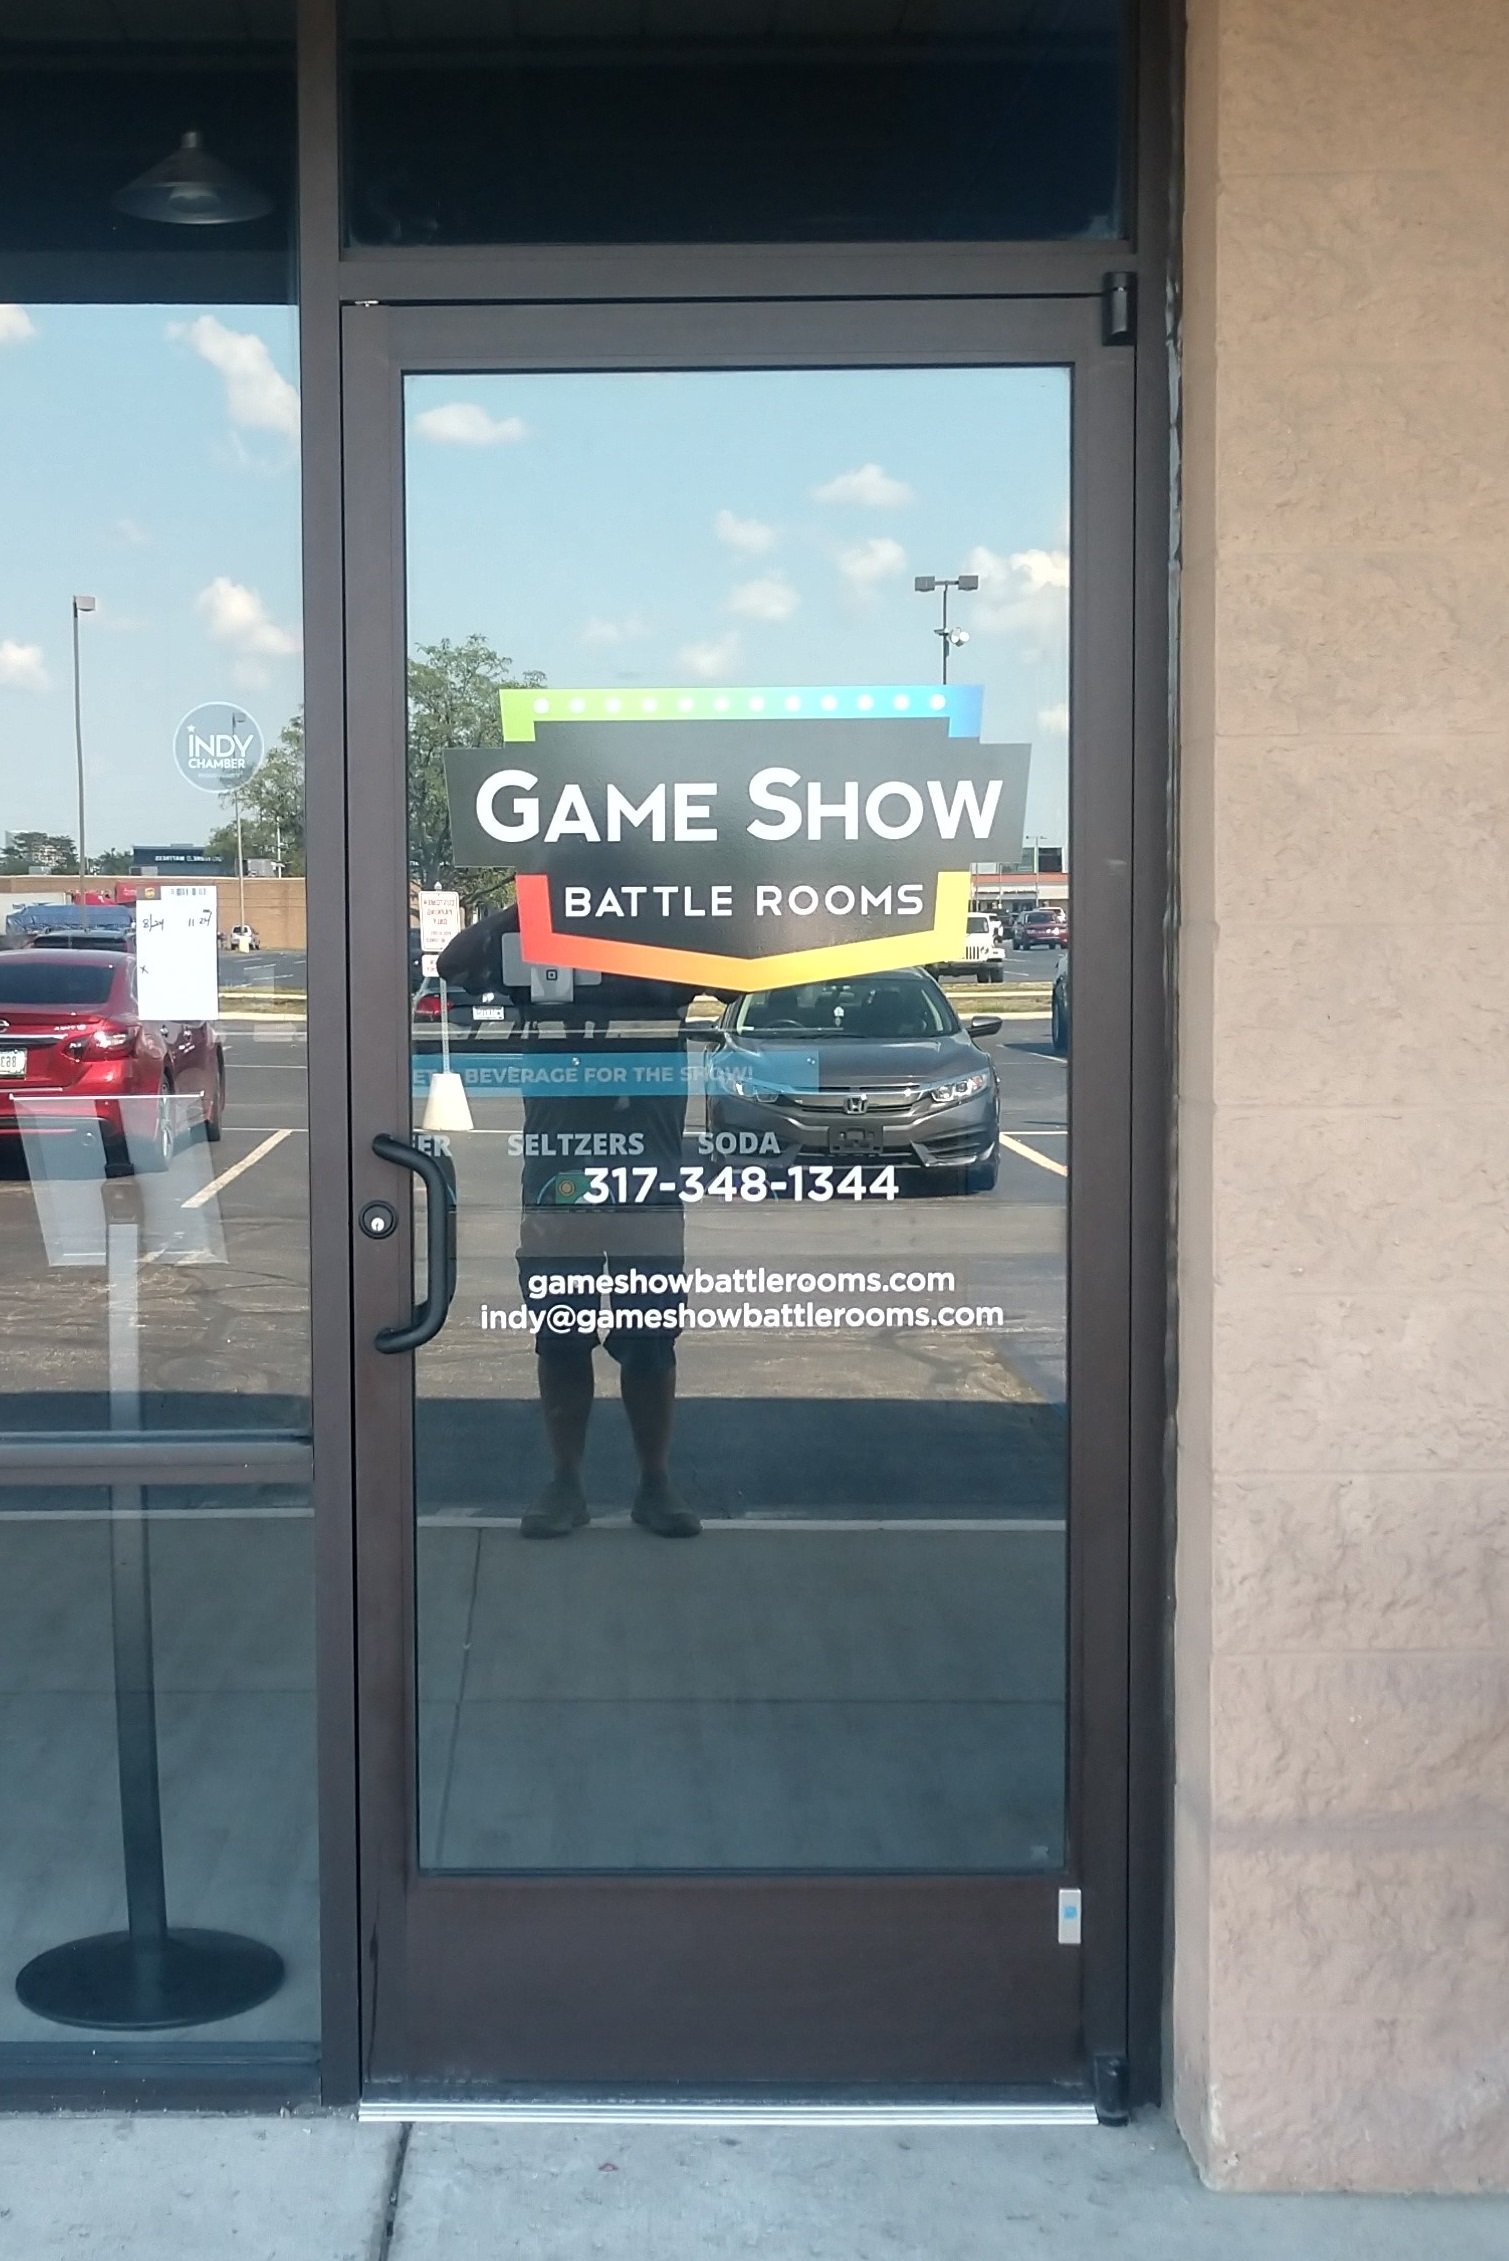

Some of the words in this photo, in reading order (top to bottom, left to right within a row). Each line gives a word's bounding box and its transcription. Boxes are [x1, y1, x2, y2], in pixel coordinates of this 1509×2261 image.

[188, 733, 254, 758] INDY
[188, 758, 246, 769] CHAMBER
[475, 769, 718, 843] GAME
[746, 766, 1004, 841] SHOW
[565, 885, 733, 918] BATTLE
[756, 884, 925, 917] ROOMS
[464, 1066, 578, 1084] BEVERAGE
[584, 1066, 627, 1083] FOR
[633, 1066, 673, 1082] THE
[411, 1134, 453, 1157] ER
[507, 1133, 645, 1156] SELTZERS
[698, 1131, 781, 1155] SODA
[582, 1165, 899, 1203] 317-348-1344
[528, 1267, 955, 1299] gameshowbattlerooms.com
[480, 1302, 1004, 1334] indy@gameshowbattlerooms.com
